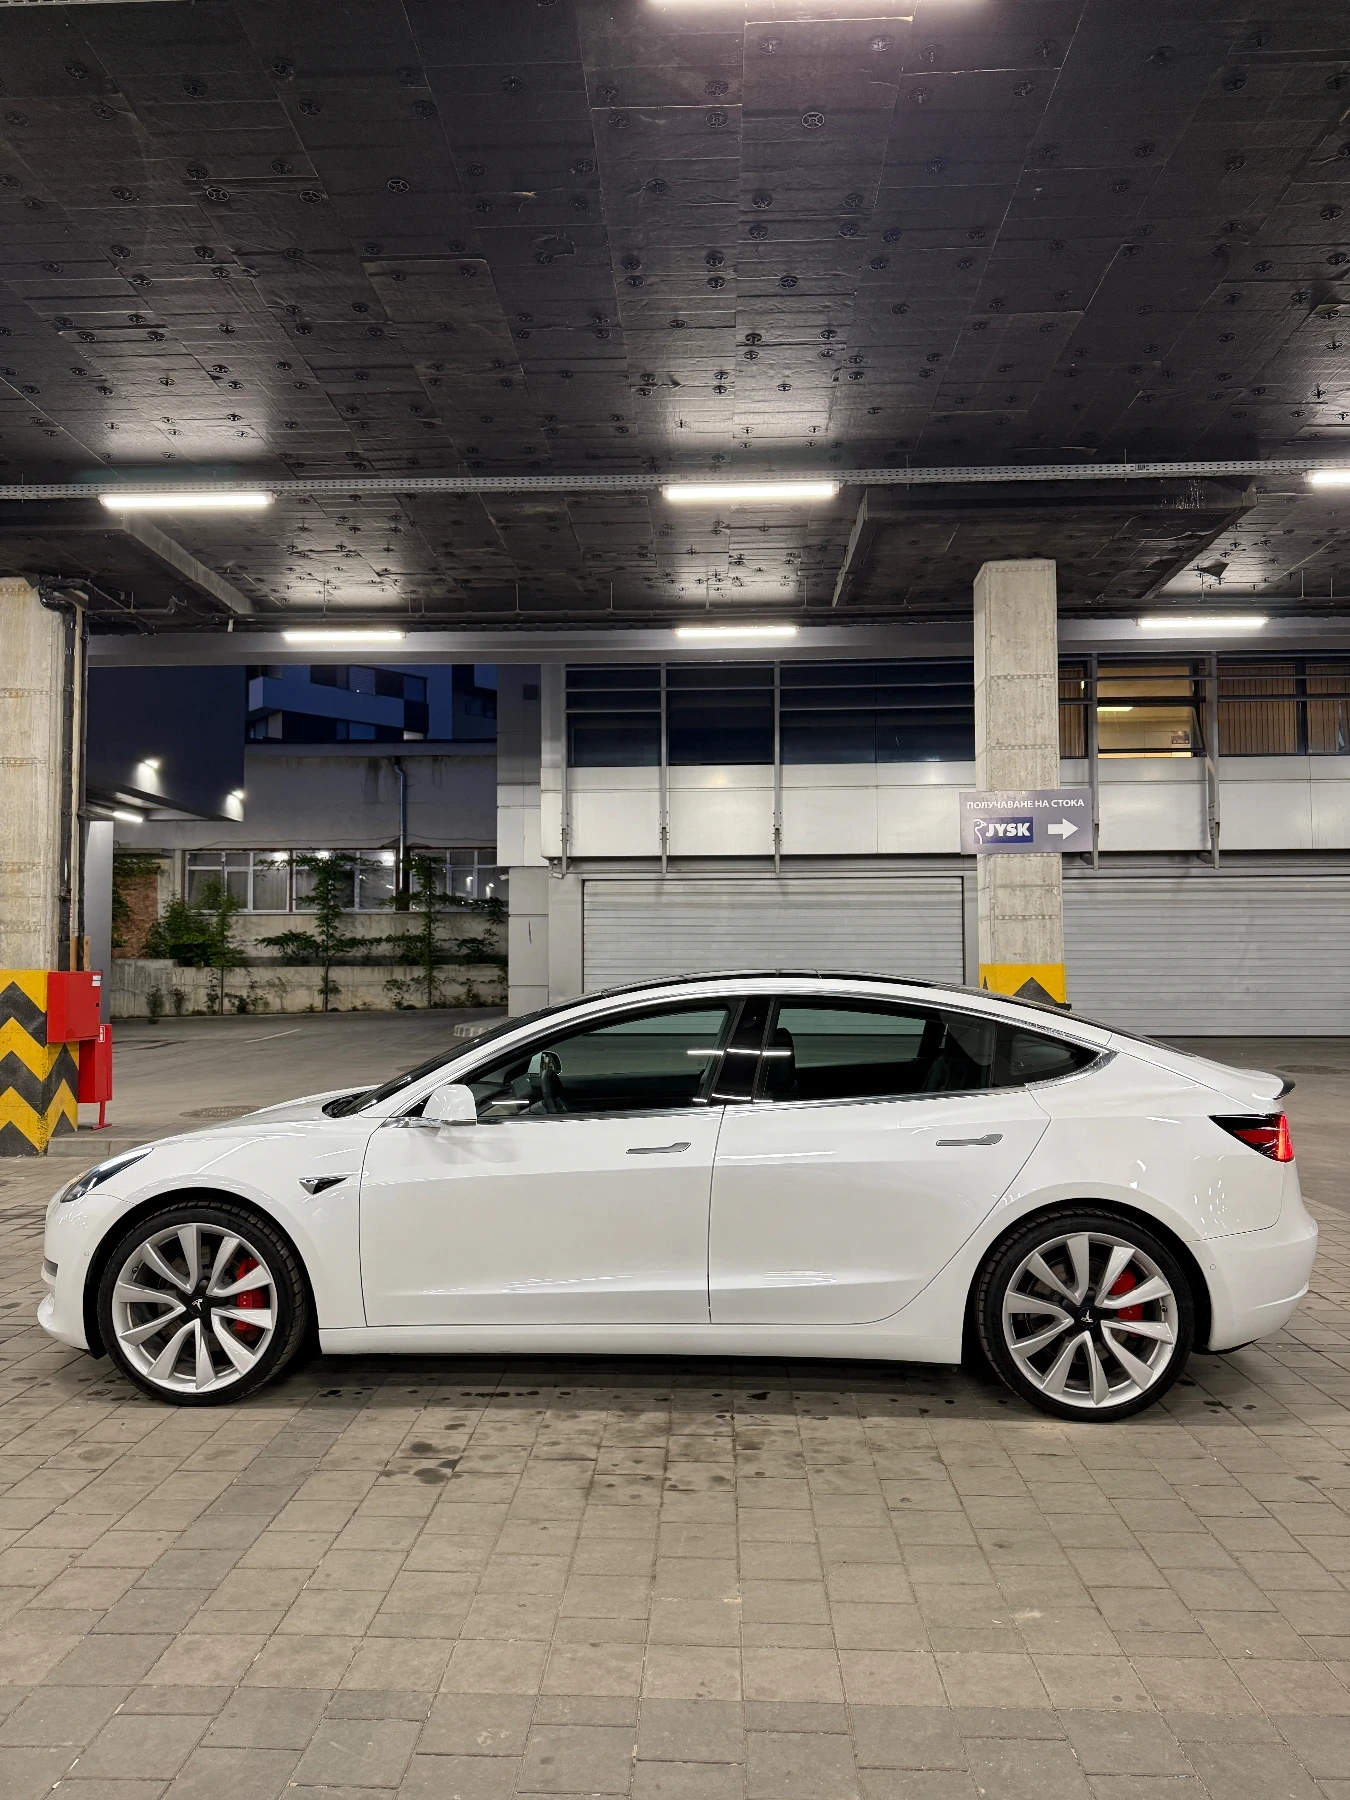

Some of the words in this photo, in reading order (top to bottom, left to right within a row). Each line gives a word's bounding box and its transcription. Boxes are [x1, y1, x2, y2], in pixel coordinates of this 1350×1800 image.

[966, 800, 1033, 809] ПОЛУЧАВАНЕ
[1035, 800, 1049, 808] НА
[1051, 799, 1085, 808] СТОКА
[985, 822, 1031, 837] JYSK
